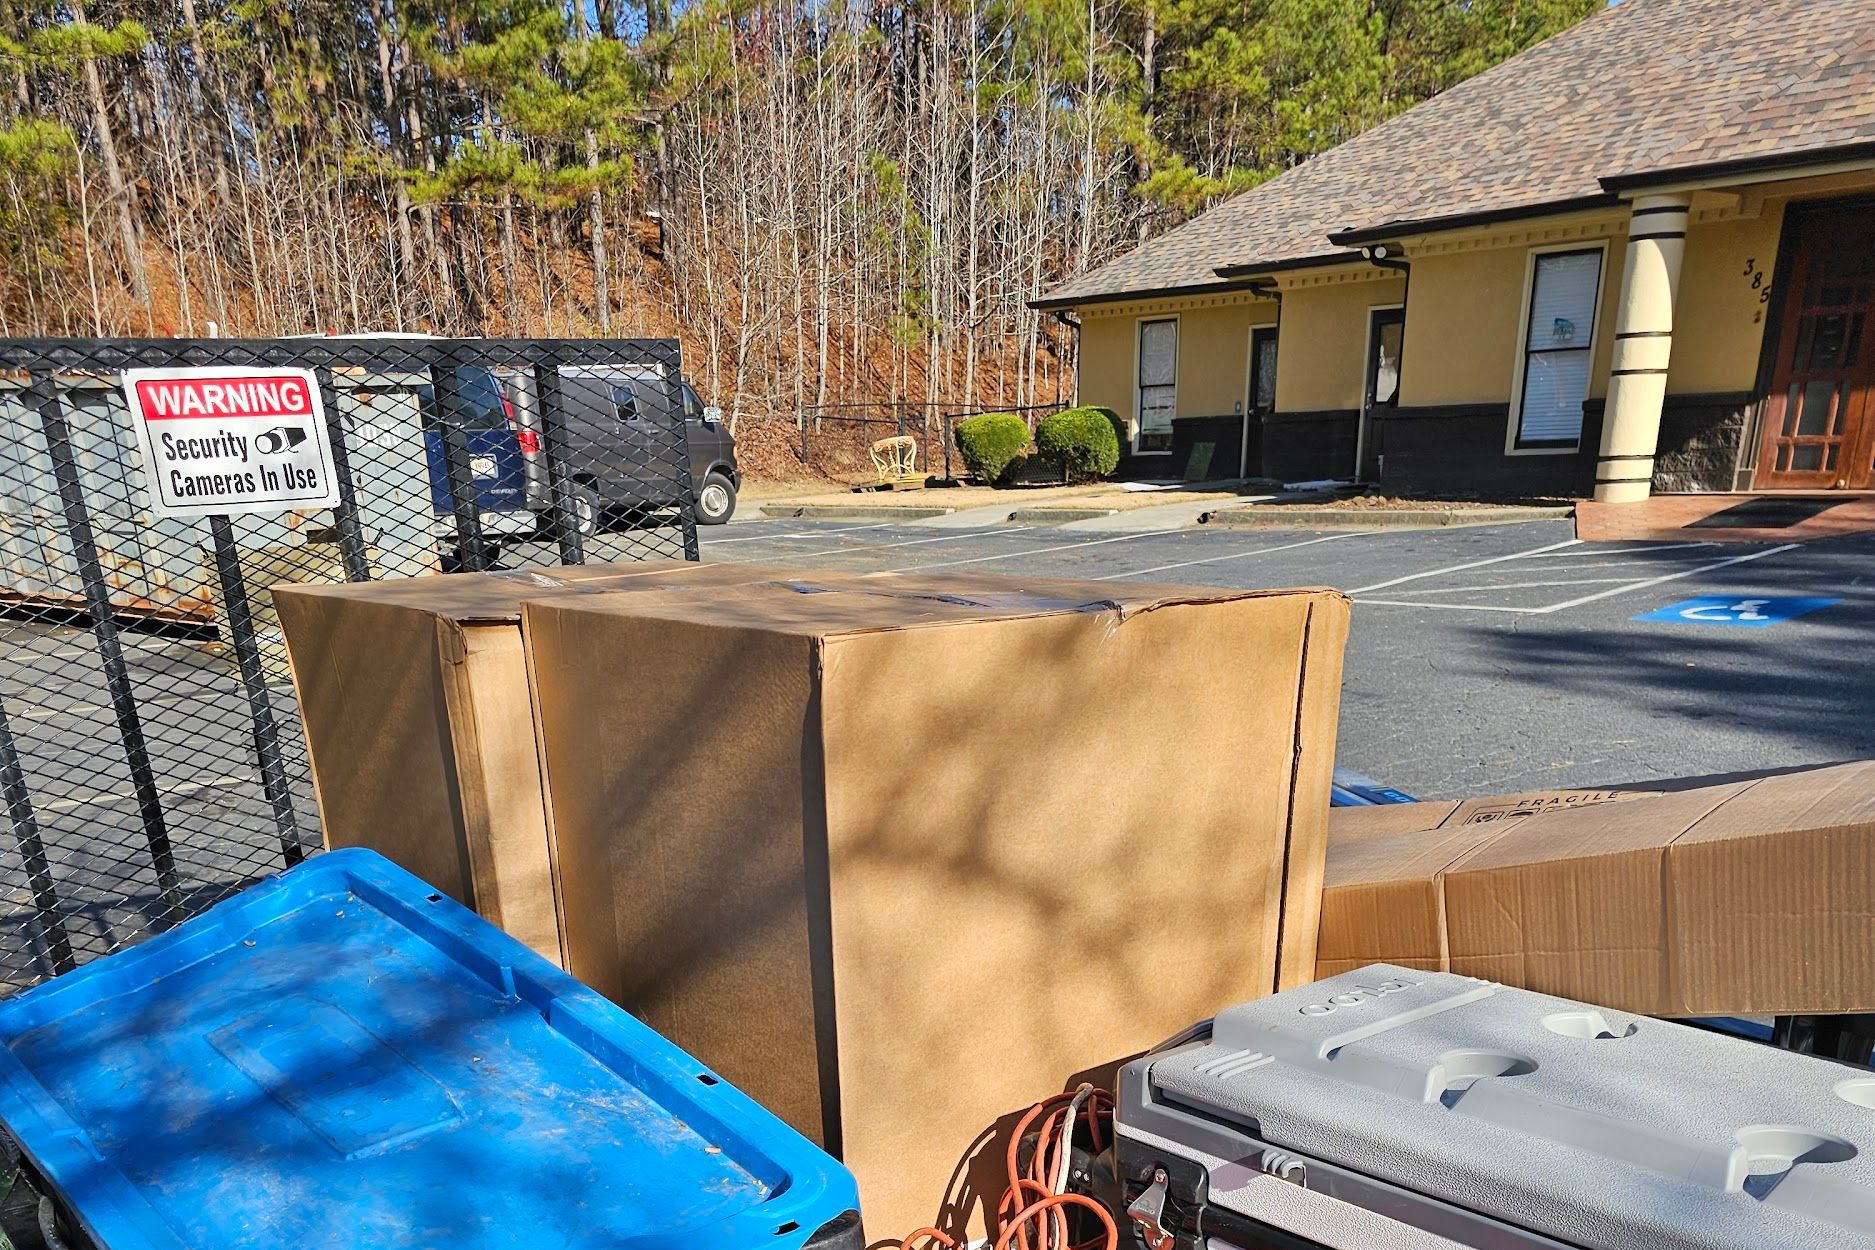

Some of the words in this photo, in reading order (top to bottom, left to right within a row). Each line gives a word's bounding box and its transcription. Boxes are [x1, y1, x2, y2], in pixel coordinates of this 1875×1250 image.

[147, 382, 305, 416] WARNING
[161, 430, 247, 463] Security
[170, 469, 257, 498] Cameras
[259, 464, 280, 492] In
[282, 462, 318, 491] Use
[1516, 791, 1619, 808] FRAGILE
